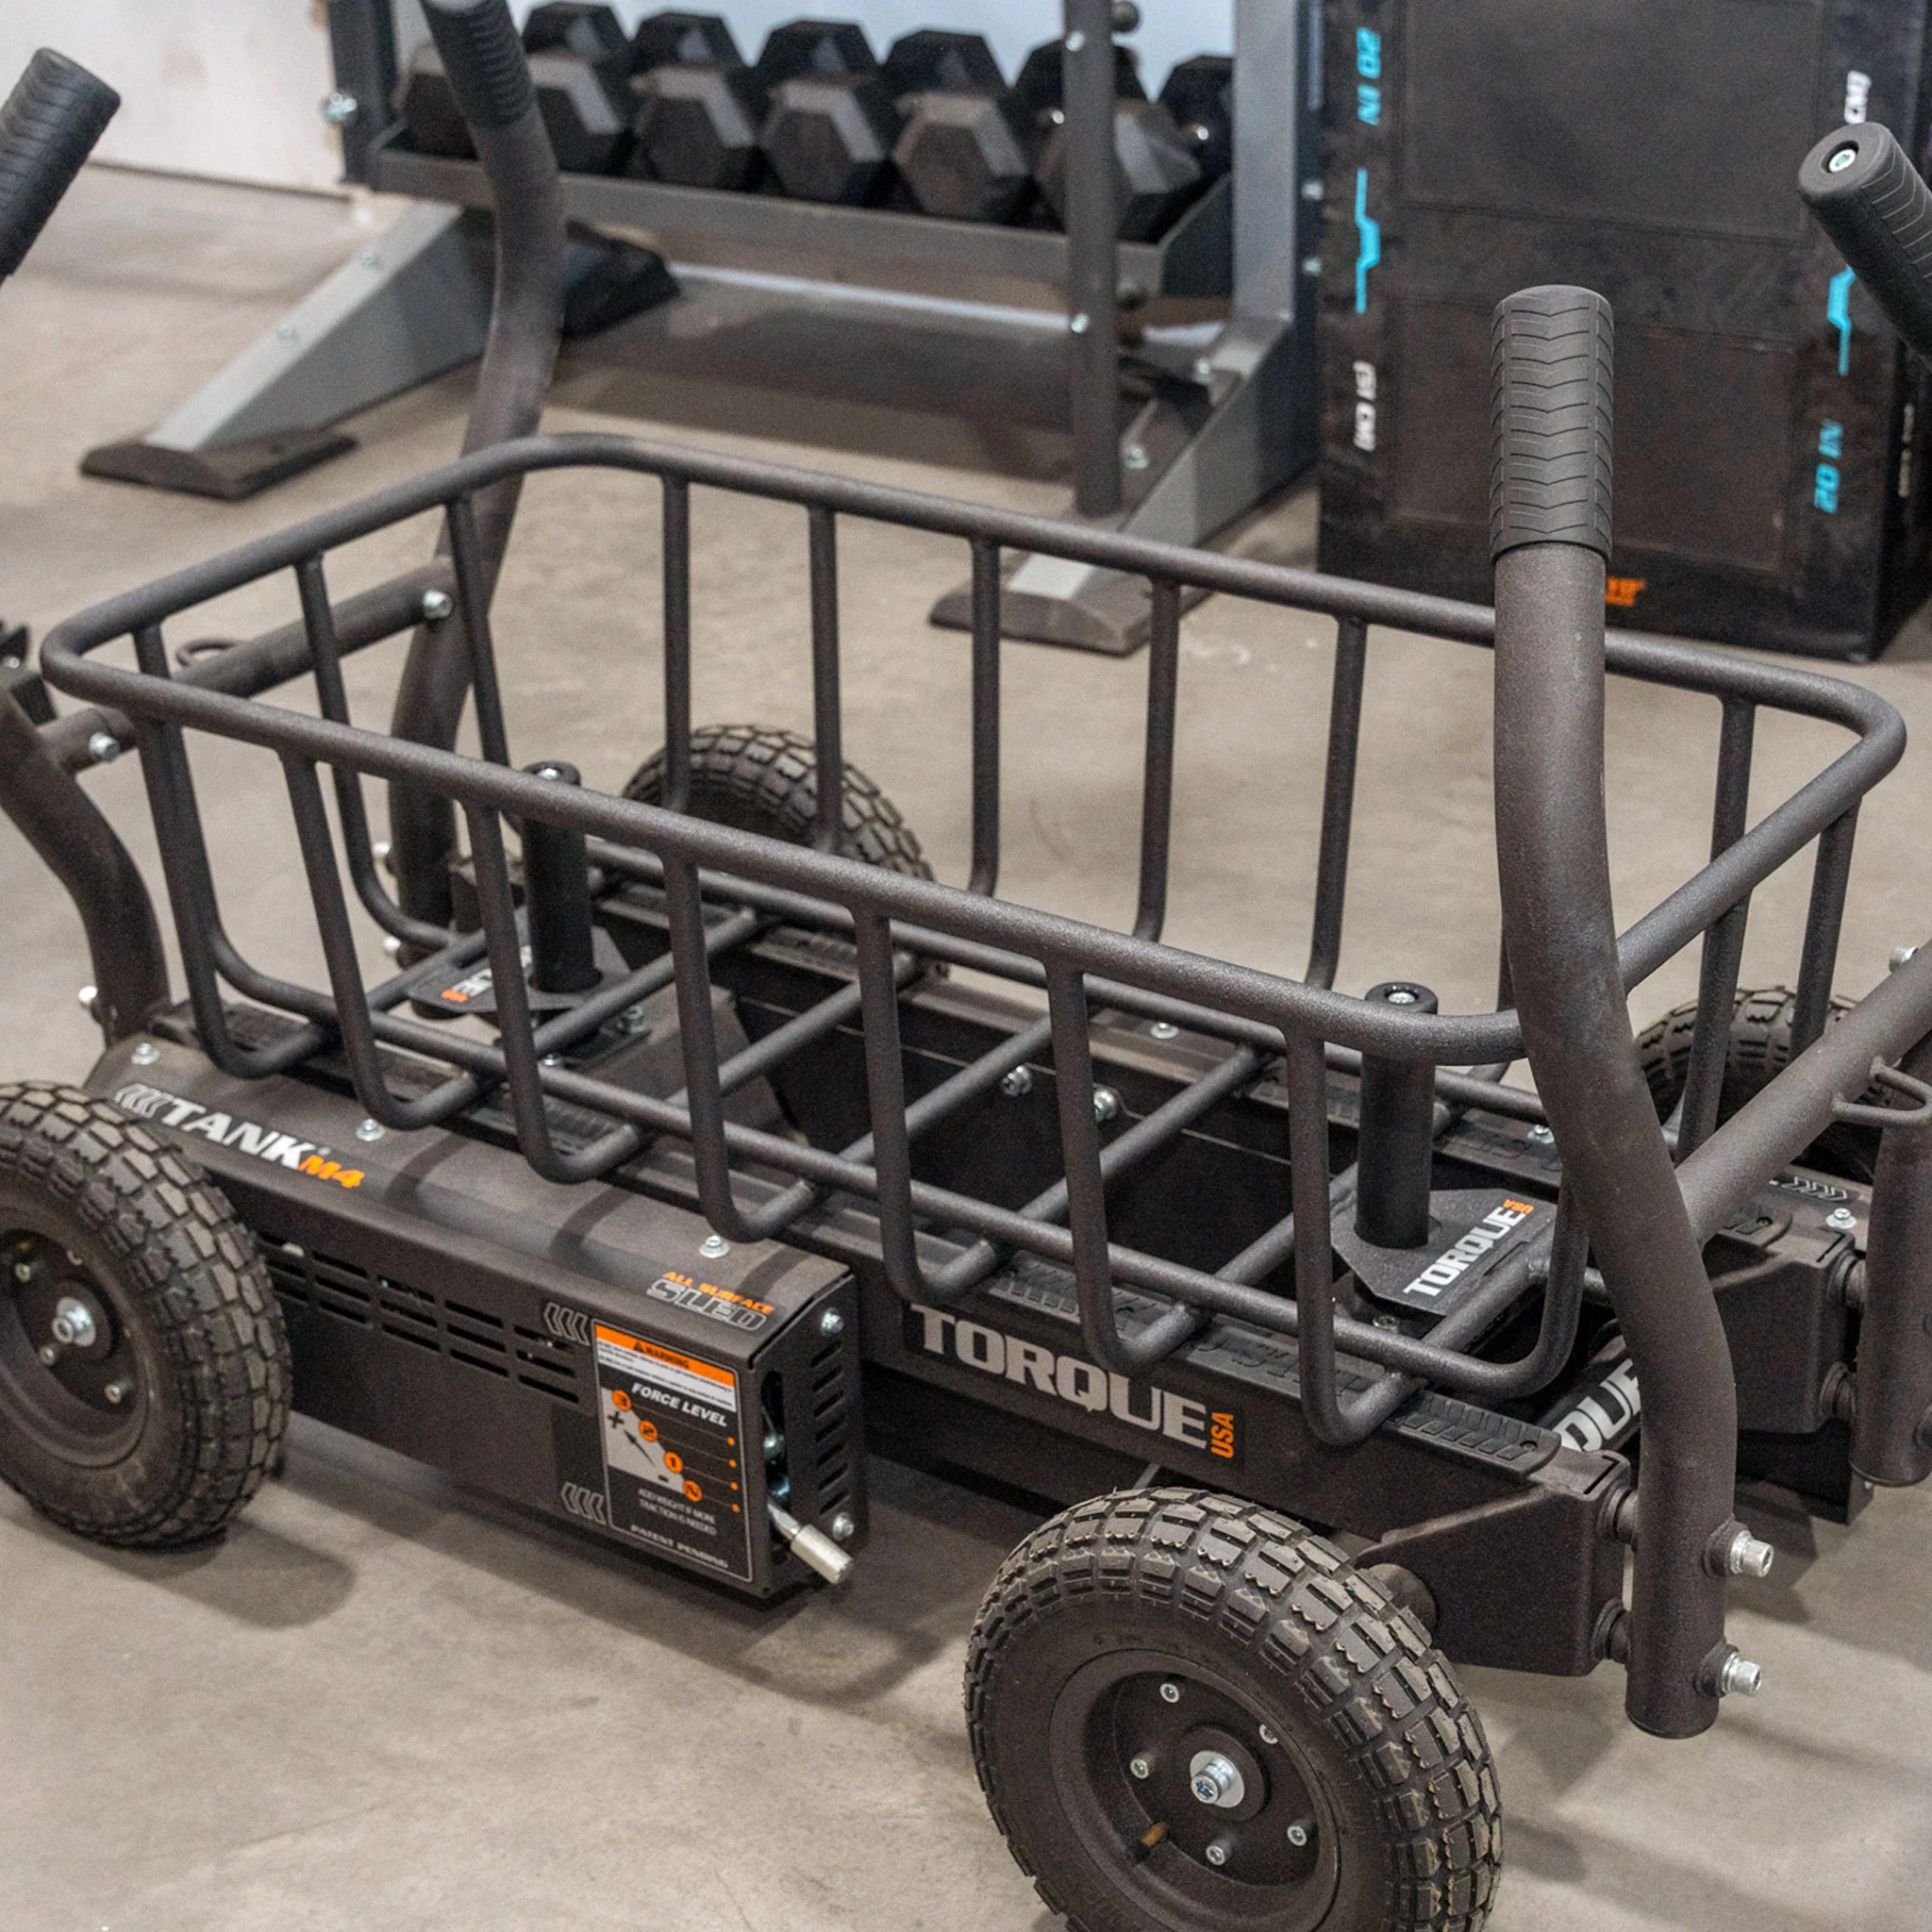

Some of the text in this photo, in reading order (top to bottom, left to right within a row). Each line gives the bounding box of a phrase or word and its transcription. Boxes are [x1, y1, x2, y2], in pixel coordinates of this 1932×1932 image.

[1357, 26, 1381, 79] 20
[161, 1098, 365, 1189] TANK M4
[1403, 1198, 1535, 1296] TORQUE USA
[645, 1278, 767, 1331] SLED
[662, 1271, 774, 1315] ALL SURFACE
[631, 1382, 728, 1427] FORCE LEVEL
[910, 1303, 1208, 1449] TORQUE
[1211, 1411, 1234, 1458] USA
